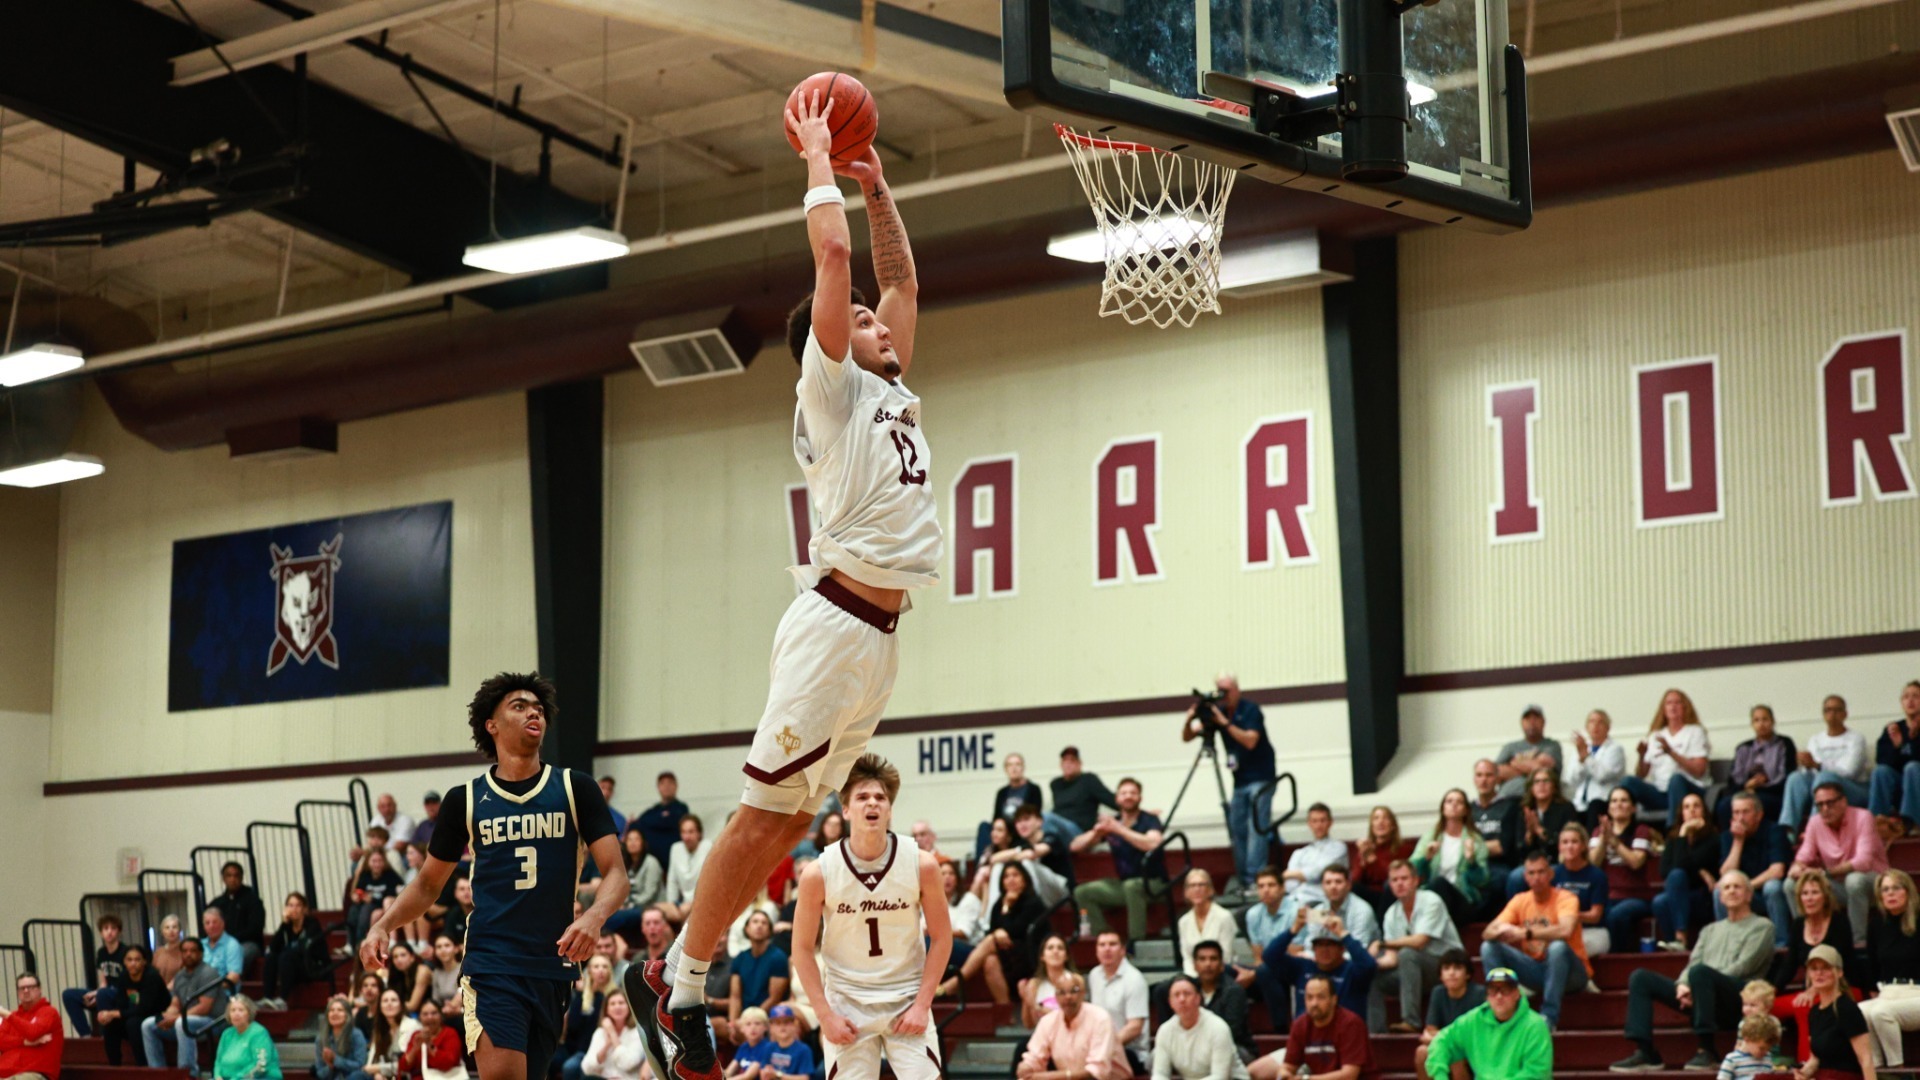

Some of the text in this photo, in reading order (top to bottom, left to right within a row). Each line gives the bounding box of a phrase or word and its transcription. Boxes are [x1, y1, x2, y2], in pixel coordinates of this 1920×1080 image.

[785, 328, 1918, 603] ARRIOR
[890, 429, 926, 486] 12
[919, 734, 995, 773] HOME
[478, 811, 566, 846] SECOND
[514, 846, 537, 890] 3
[836, 897, 910, 914] St. Mike's
[864, 917, 883, 957] 1
